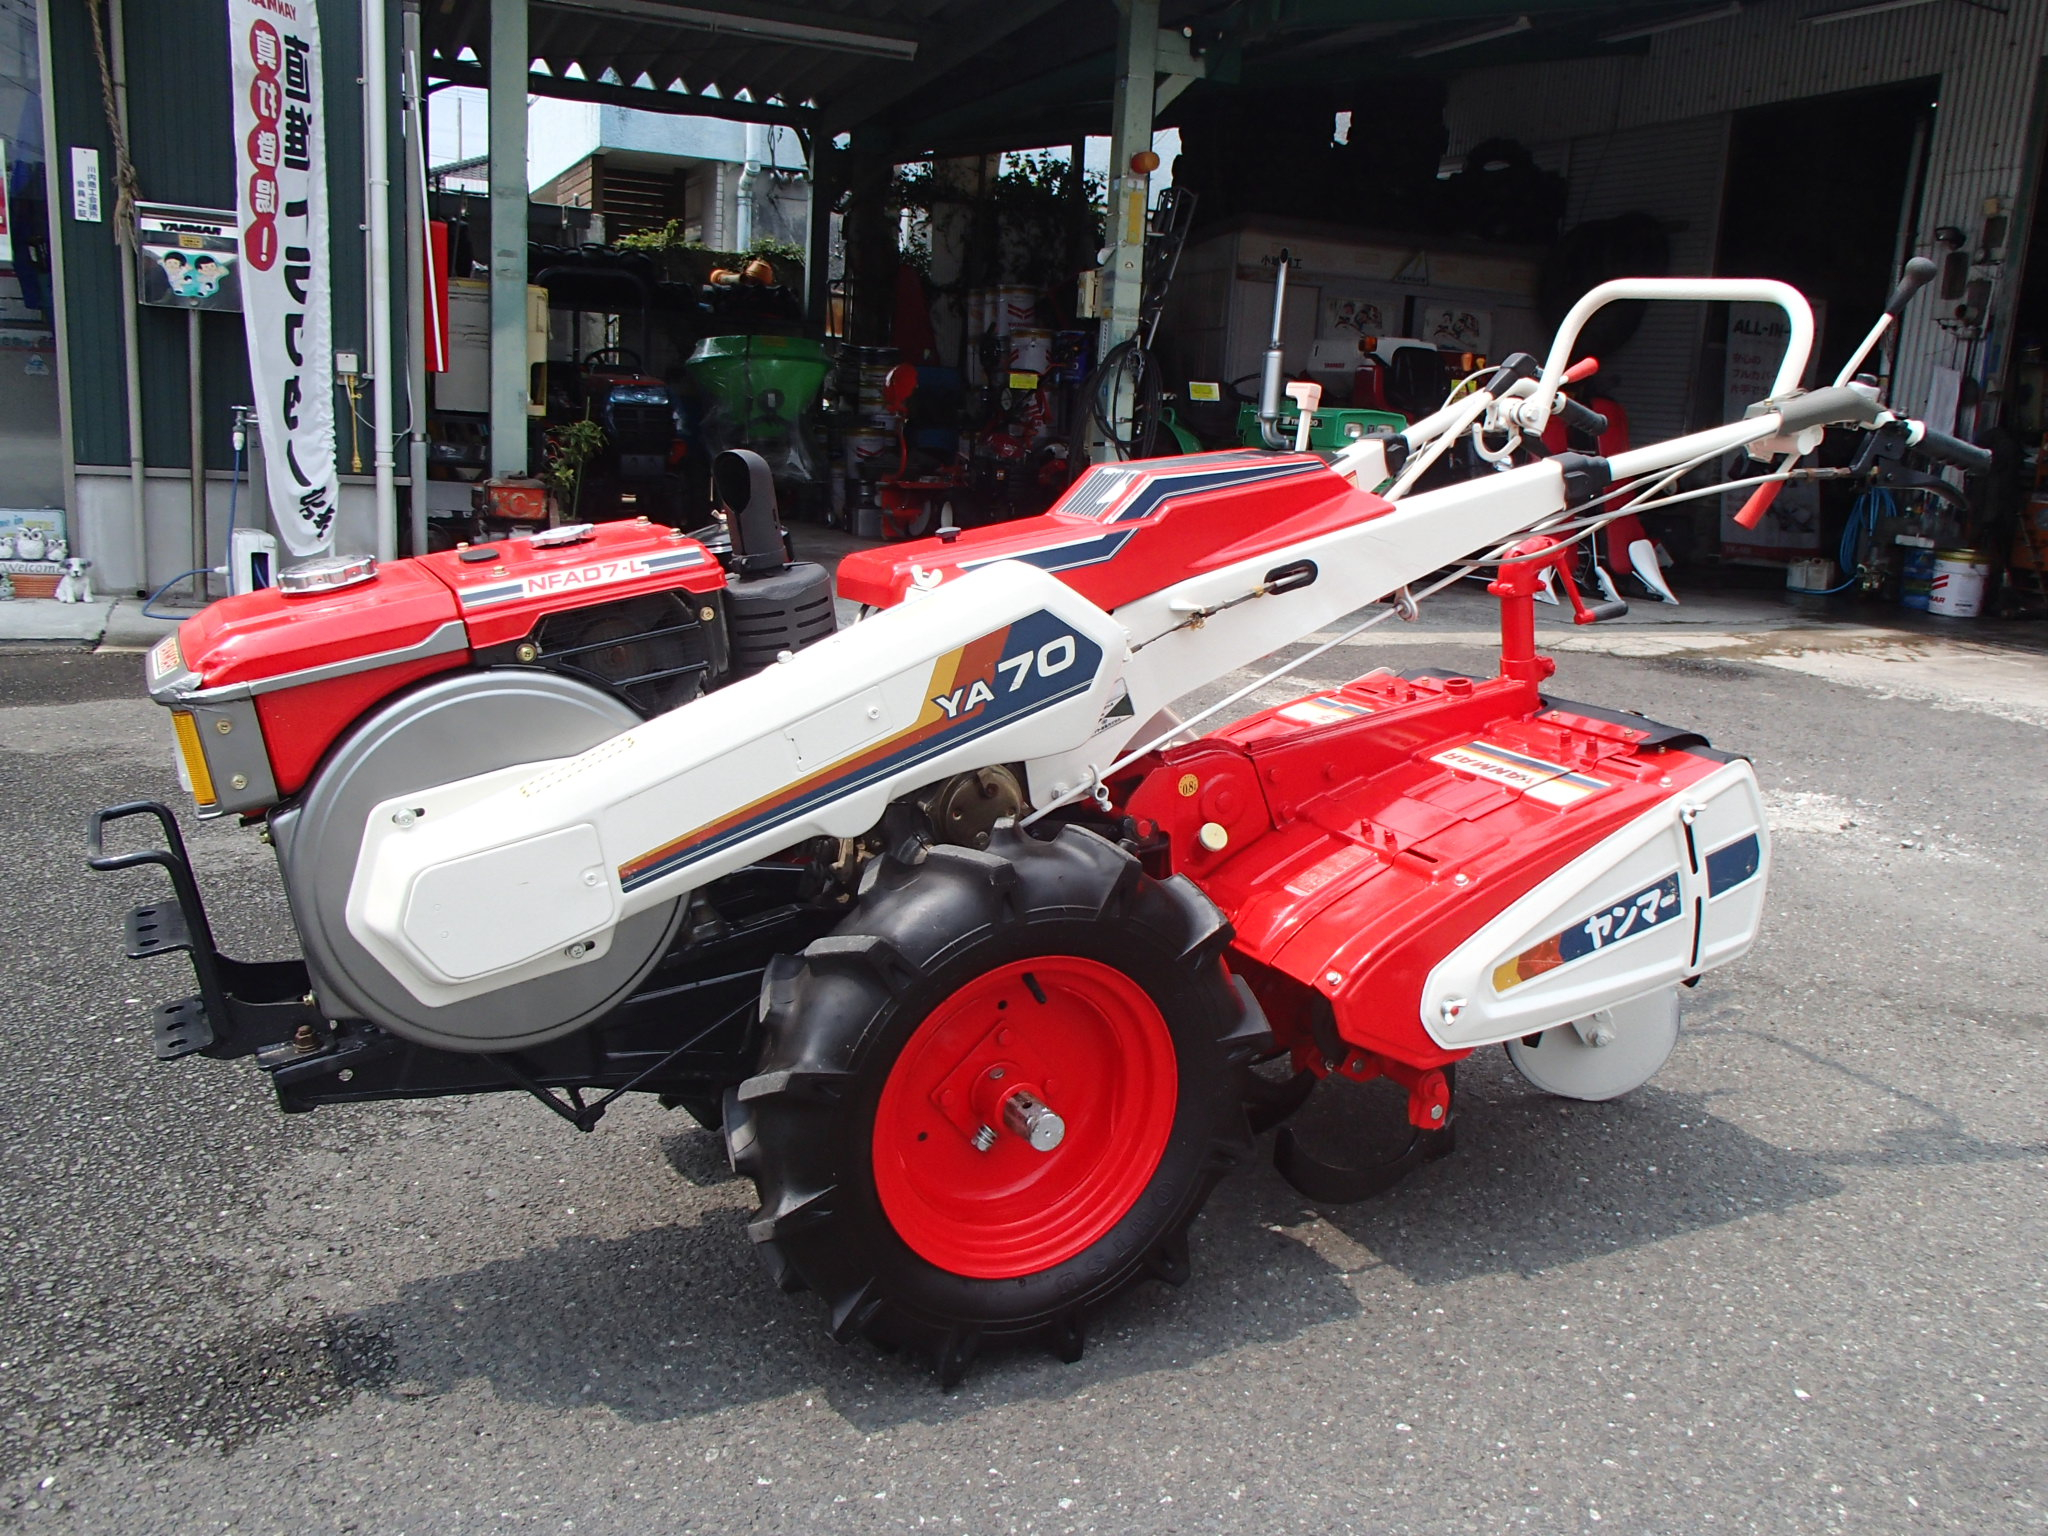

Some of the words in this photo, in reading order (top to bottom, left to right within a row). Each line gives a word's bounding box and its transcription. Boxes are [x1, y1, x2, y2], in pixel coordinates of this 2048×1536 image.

[527, 560, 645, 593] NFAD7-L
[1583, 888, 1676, 949] ヤンマー
